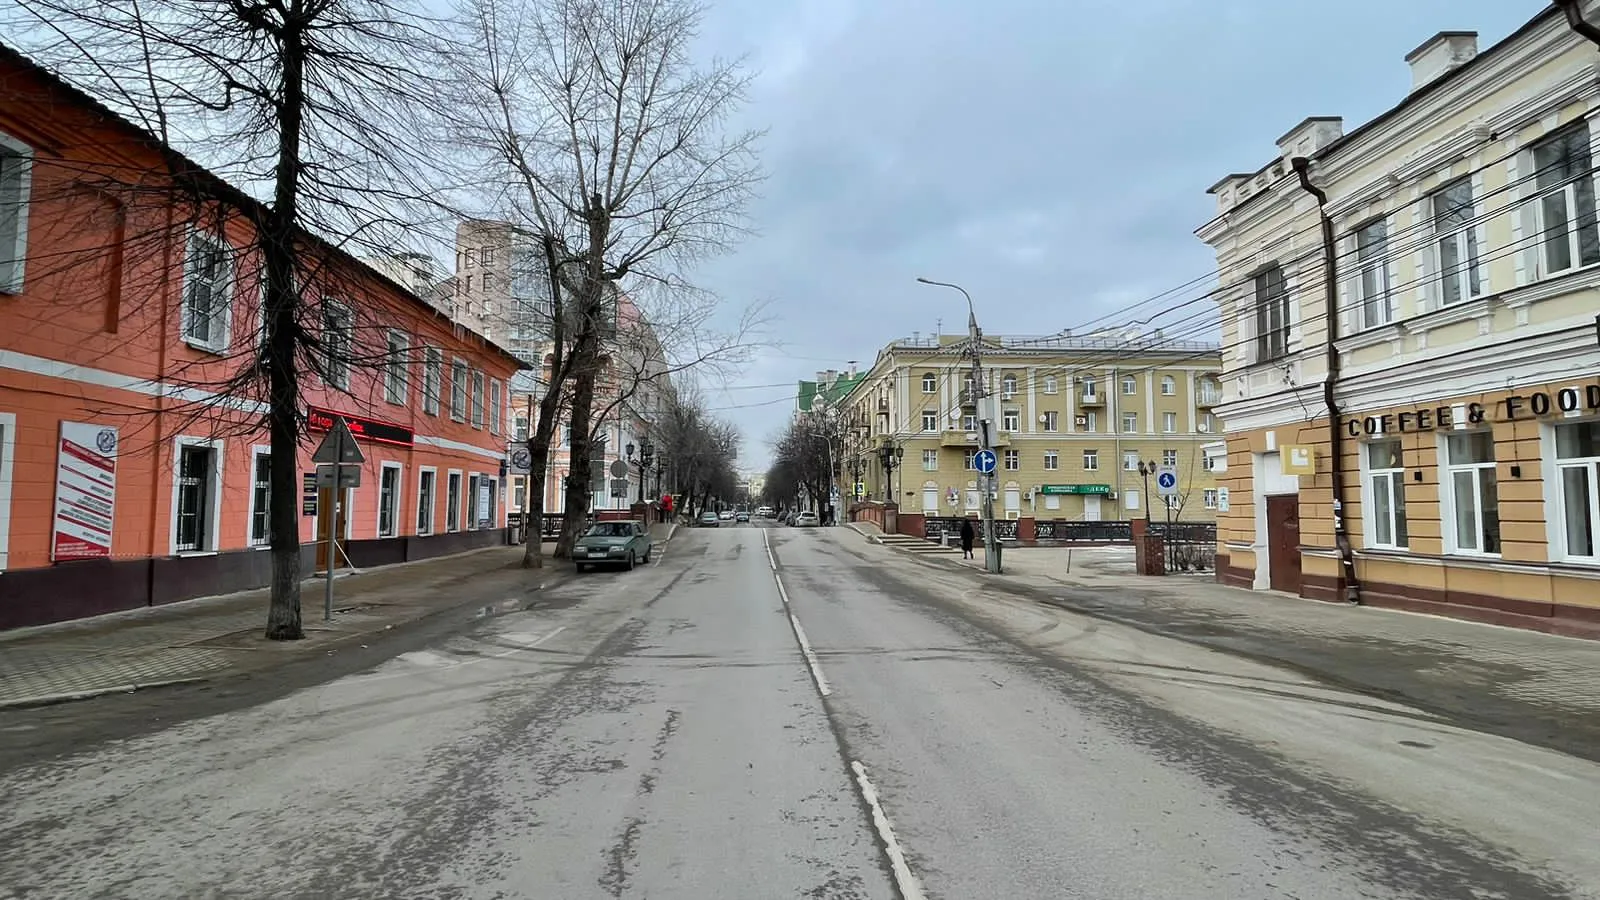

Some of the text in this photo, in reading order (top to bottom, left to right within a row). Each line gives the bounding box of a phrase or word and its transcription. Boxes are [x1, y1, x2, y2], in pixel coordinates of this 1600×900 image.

[1349, 385, 1600, 436] COFFEE & FOOD
